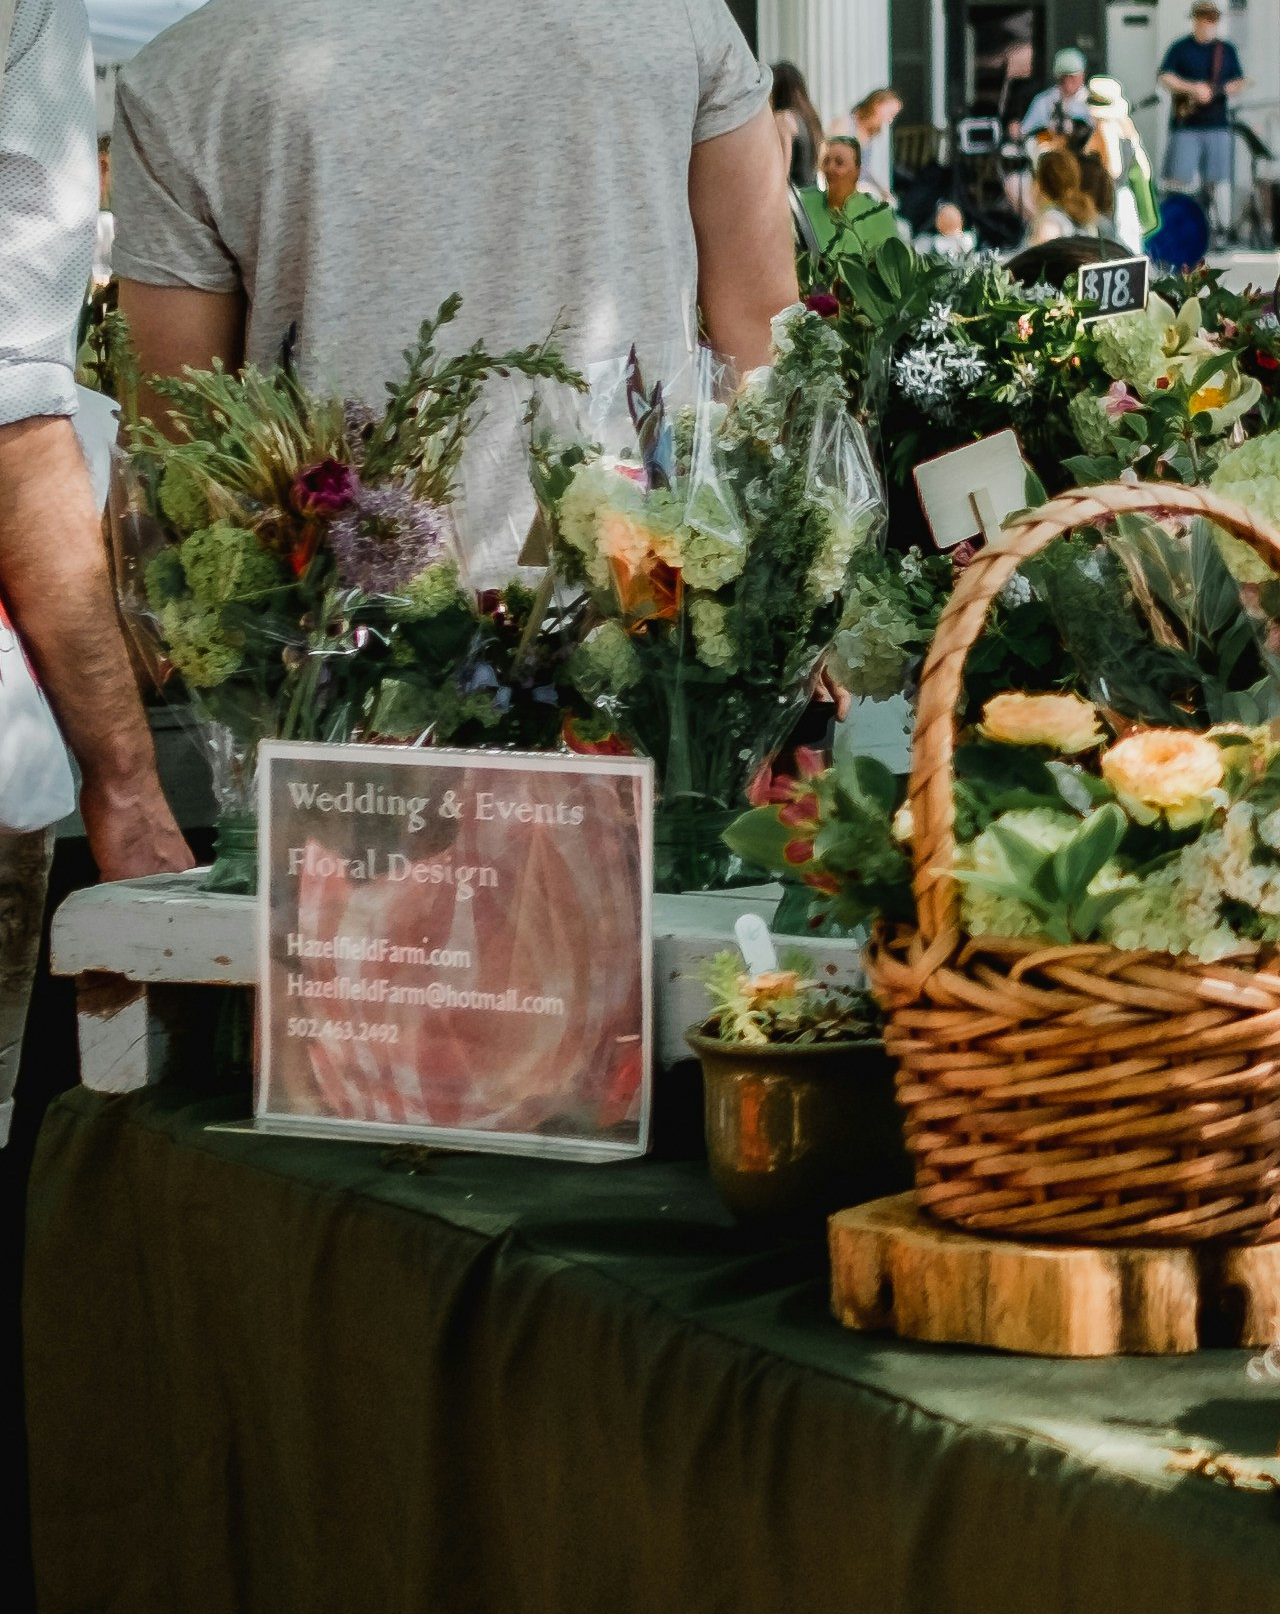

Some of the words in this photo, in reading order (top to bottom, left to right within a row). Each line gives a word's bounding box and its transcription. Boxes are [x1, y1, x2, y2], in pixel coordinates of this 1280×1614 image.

[287, 781, 431, 833] Wedding
[438, 790, 464, 819] &
[474, 792, 585, 825] Events
[287, 847, 377, 881] Floral
[387, 852, 499, 902] Design
[286, 933, 472, 969] HazelfieldFarm.com
[286, 972, 566, 1016] HazelfieldFarm@hotmail.com
